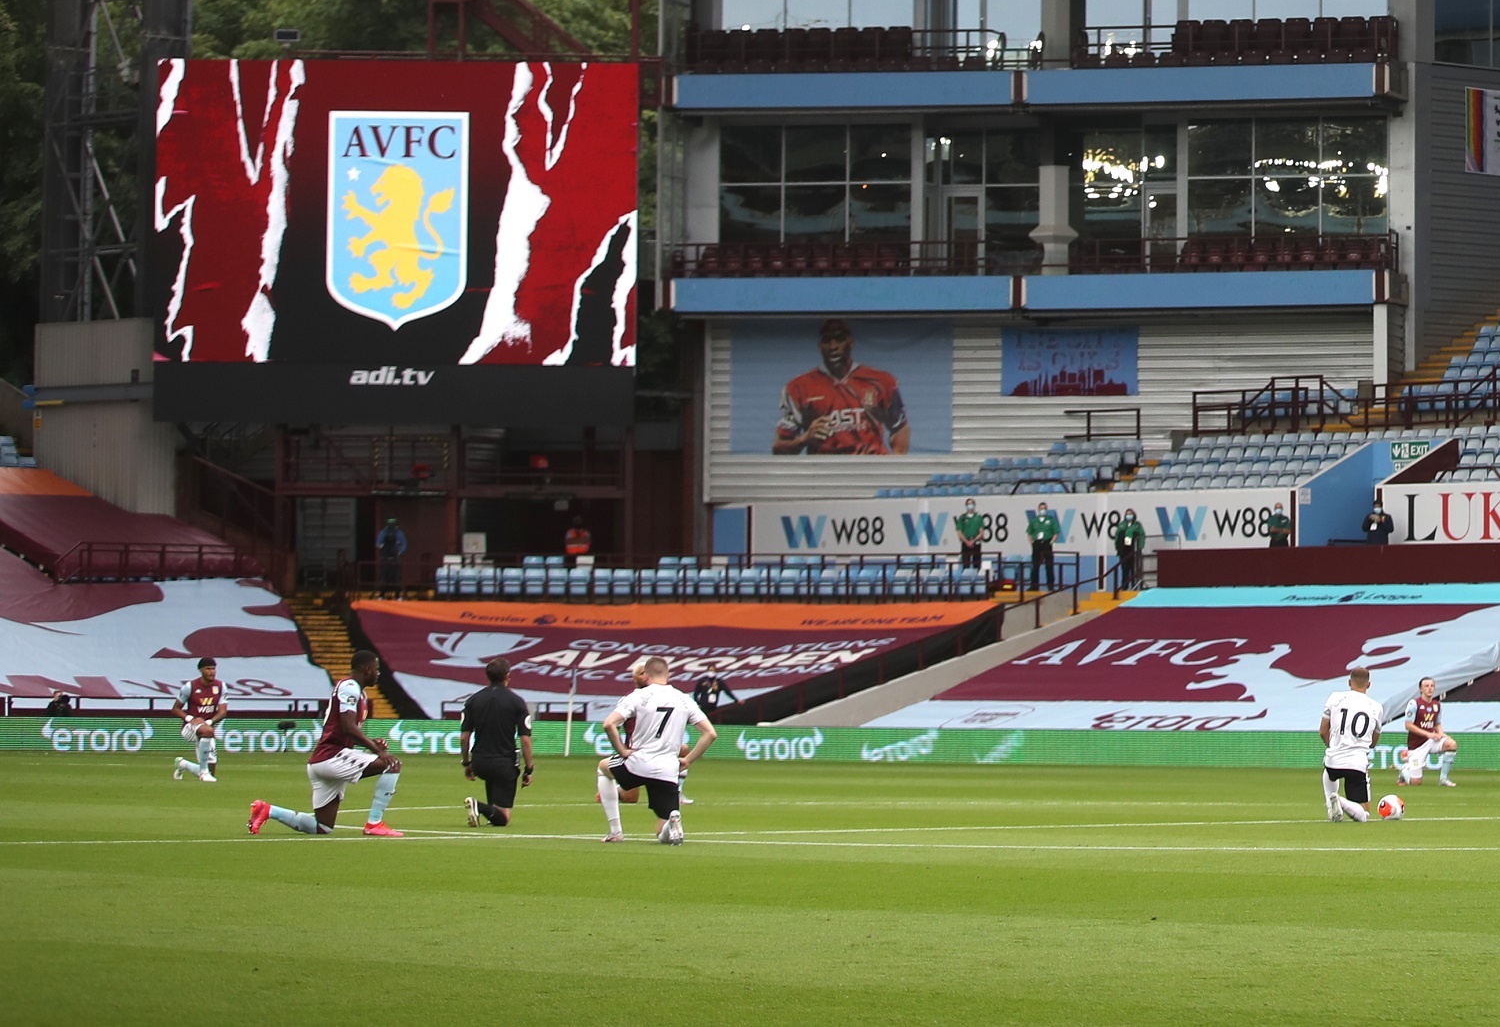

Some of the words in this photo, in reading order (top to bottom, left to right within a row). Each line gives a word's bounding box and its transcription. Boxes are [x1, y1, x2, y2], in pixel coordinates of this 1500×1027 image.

[342, 124, 457, 160] AVFC
[349, 365, 435, 386] adi.tv
[1410, 444, 1429, 454] EXIT
[831, 515, 885, 546] W88
[1081, 509, 1121, 540] W8
[1213, 506, 1272, 539] W88
[1279, 593, 1339, 603] Premier
[1363, 591, 1424, 602] League
[459, 611, 528, 624] Premier
[563, 615, 632, 627] League
[801, 618, 826, 626] WE
[830, 617, 863, 625] ARE
[867, 616, 900, 624] ONE
[900, 614, 945, 624] TEAM
[568, 637, 897, 656] CONGRATULATIONS
[1012, 638, 1250, 667] AVFC
[528, 649, 631, 669] AV
[510, 660, 615, 680] FAWC
[655, 707, 675, 739] 7
[1340, 707, 1370, 738] 10
